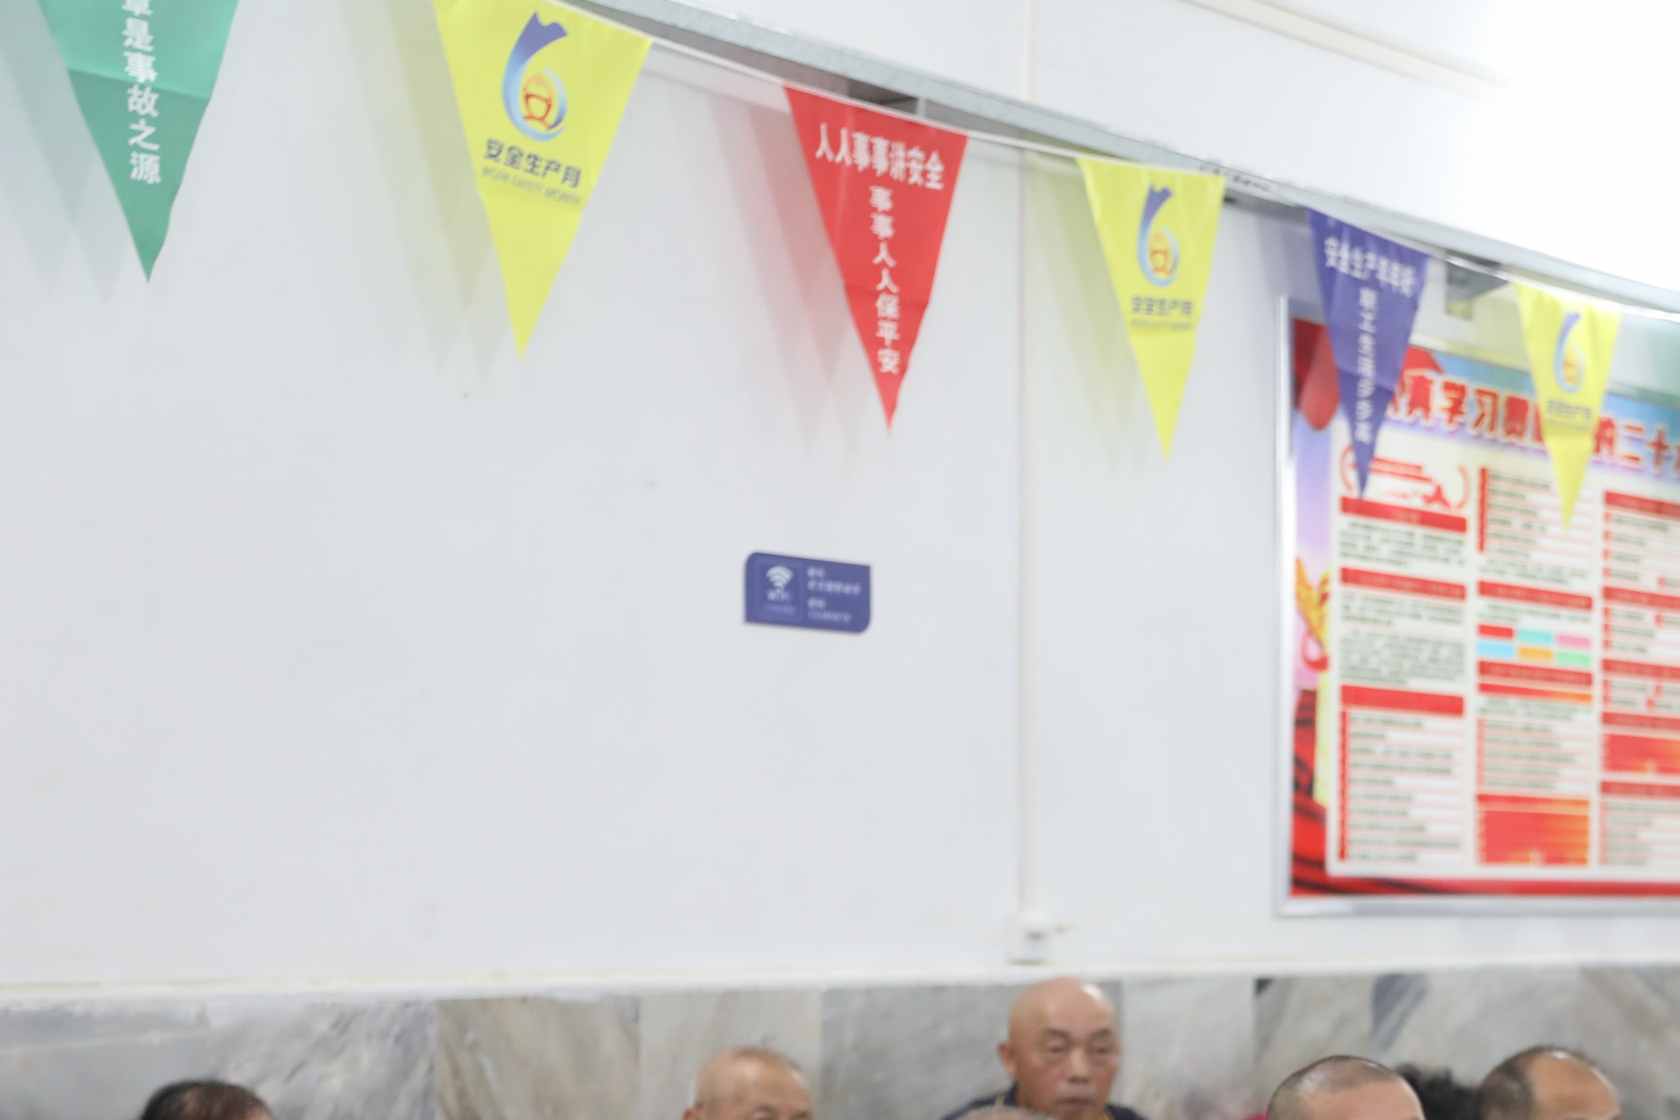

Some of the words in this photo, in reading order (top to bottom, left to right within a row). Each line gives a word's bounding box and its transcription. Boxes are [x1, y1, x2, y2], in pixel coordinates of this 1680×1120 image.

[484, 137, 582, 188] 安全生产月
[868, 185, 901, 374] 事事人人保平安
